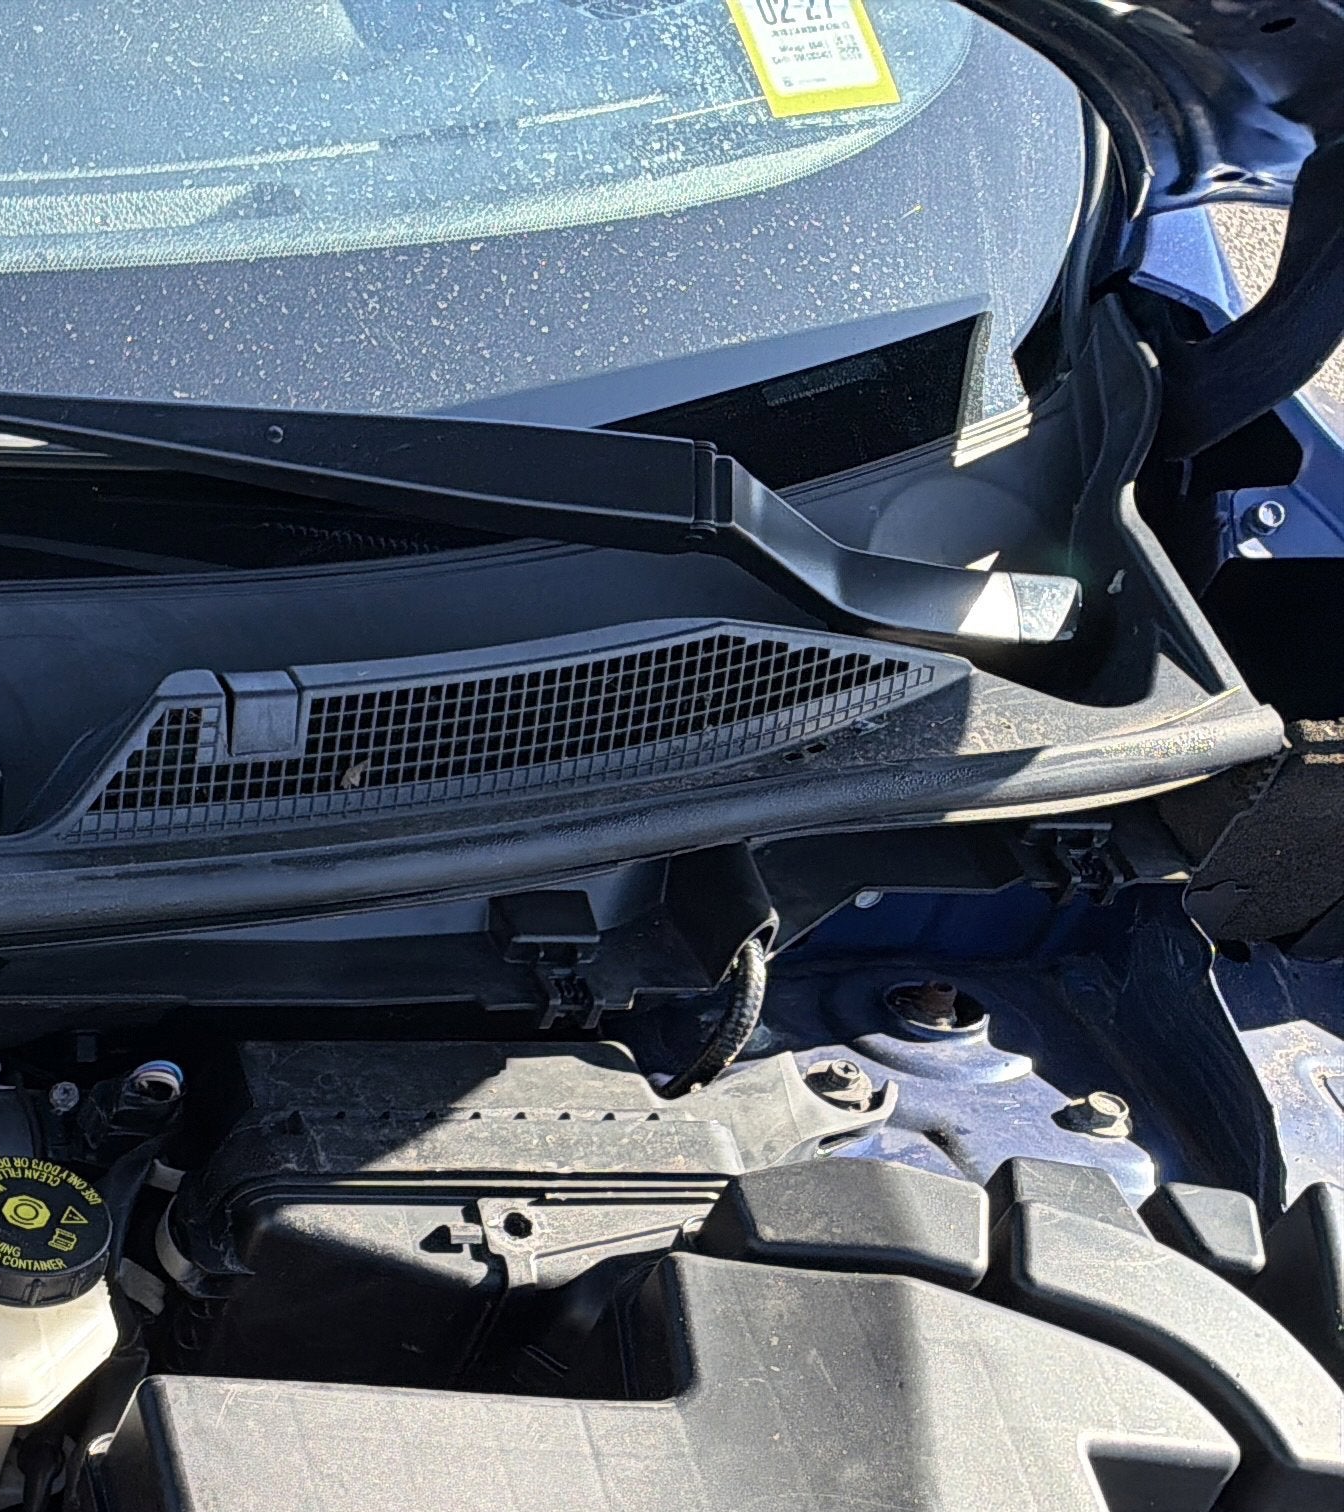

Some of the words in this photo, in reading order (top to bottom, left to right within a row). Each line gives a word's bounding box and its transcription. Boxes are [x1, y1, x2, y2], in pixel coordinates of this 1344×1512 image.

[14, 1157, 29, 1167] OR
[31, 1158, 63, 1176] DOT3
[24, 1169, 61, 1187] CLEAN
[61, 1169, 86, 1191] ONLY
[80, 1184, 103, 1206] USE
[2, 1254, 68, 1272] CONTAINER
